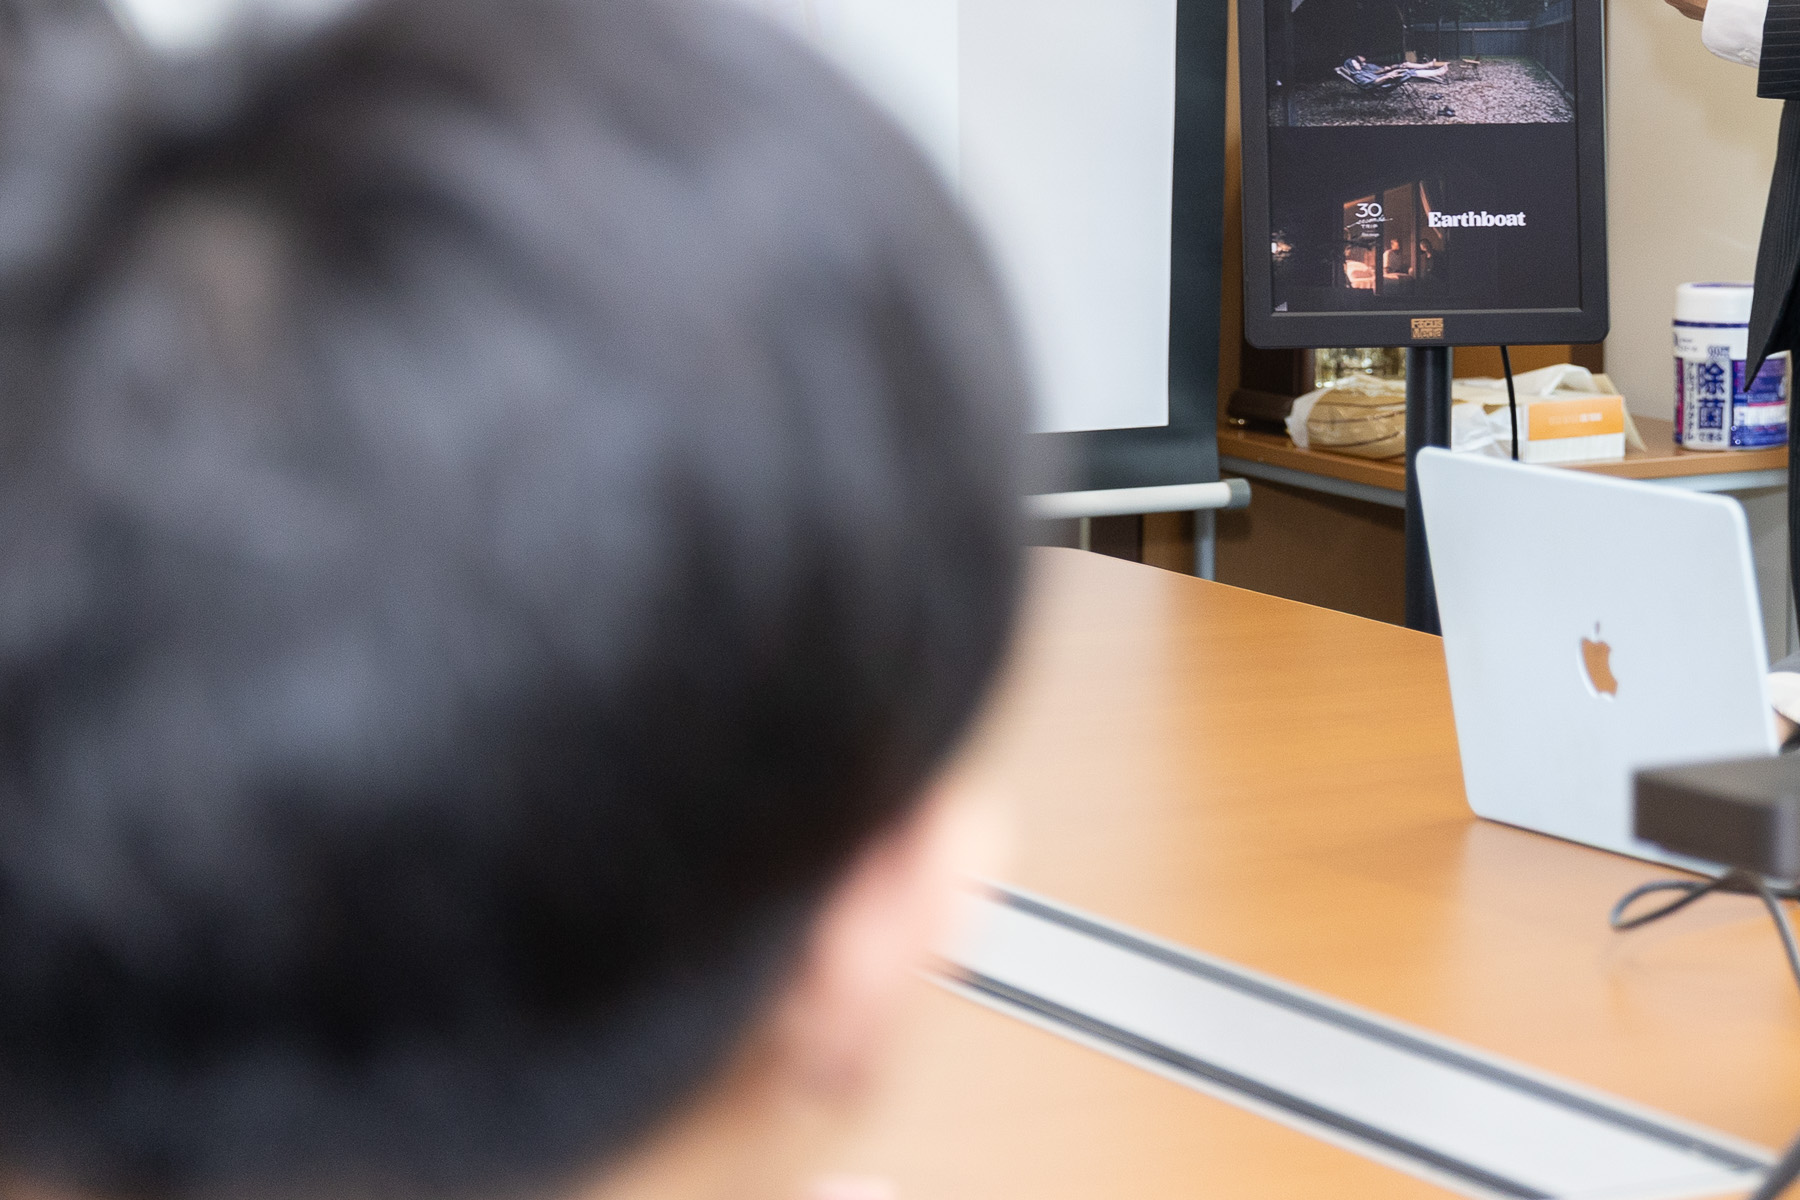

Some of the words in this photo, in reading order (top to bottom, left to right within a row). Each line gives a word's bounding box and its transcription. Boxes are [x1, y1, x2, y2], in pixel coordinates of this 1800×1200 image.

[1355, 202, 1382, 218] 30
[1428, 211, 1526, 228] Earthboat
[1697, 362, 1726, 430] 除菌
